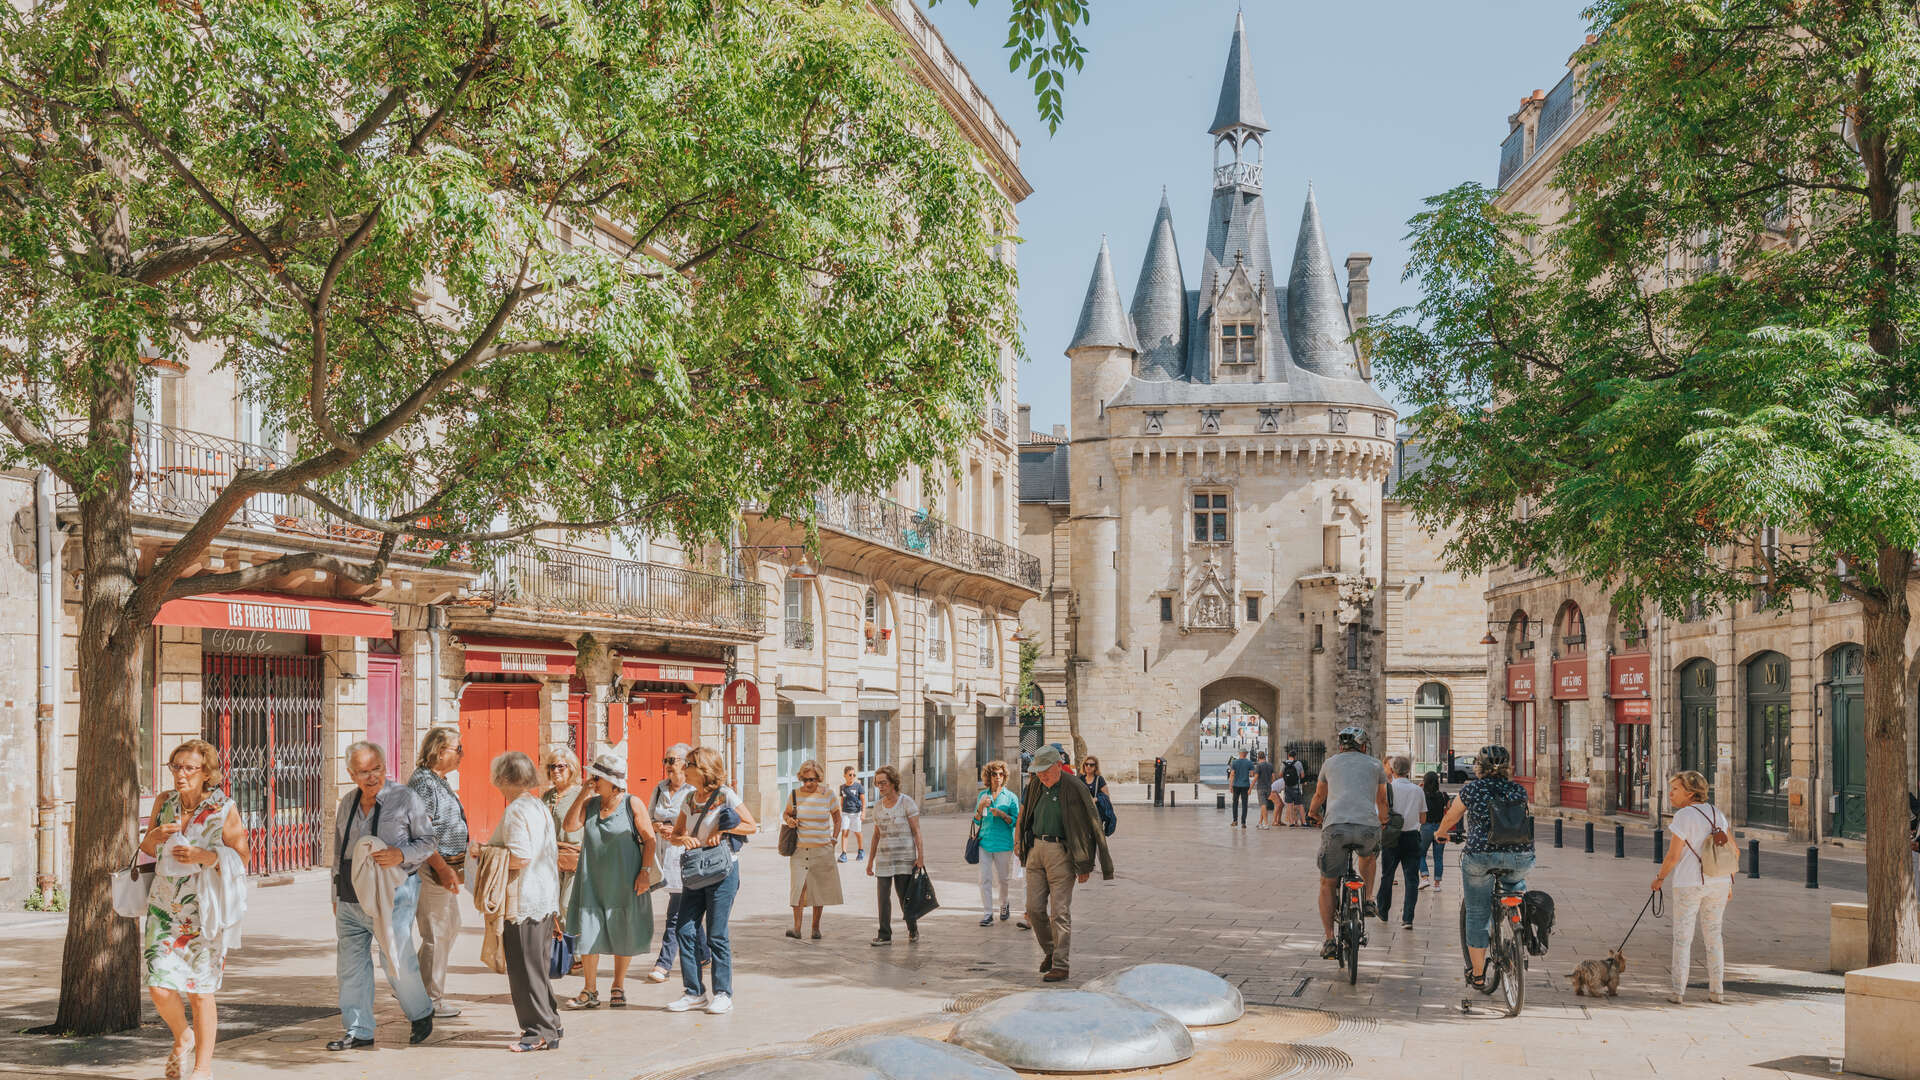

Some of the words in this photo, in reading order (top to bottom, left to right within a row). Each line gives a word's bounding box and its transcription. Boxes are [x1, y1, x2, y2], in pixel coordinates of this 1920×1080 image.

[228, 603, 243, 627] LES
[244, 605, 274, 629] FRERES
[275, 607, 311, 631] CAILLOUX
[212, 630, 272, 654] Café
[1573, 675, 1582, 686] VINS
[1620, 672, 1629, 685] ART
[1633, 672, 1643, 684] VINS
[1696, 668, 1706, 688] M
[1765, 663, 1777, 684] M
[728, 706, 736, 715] LES
